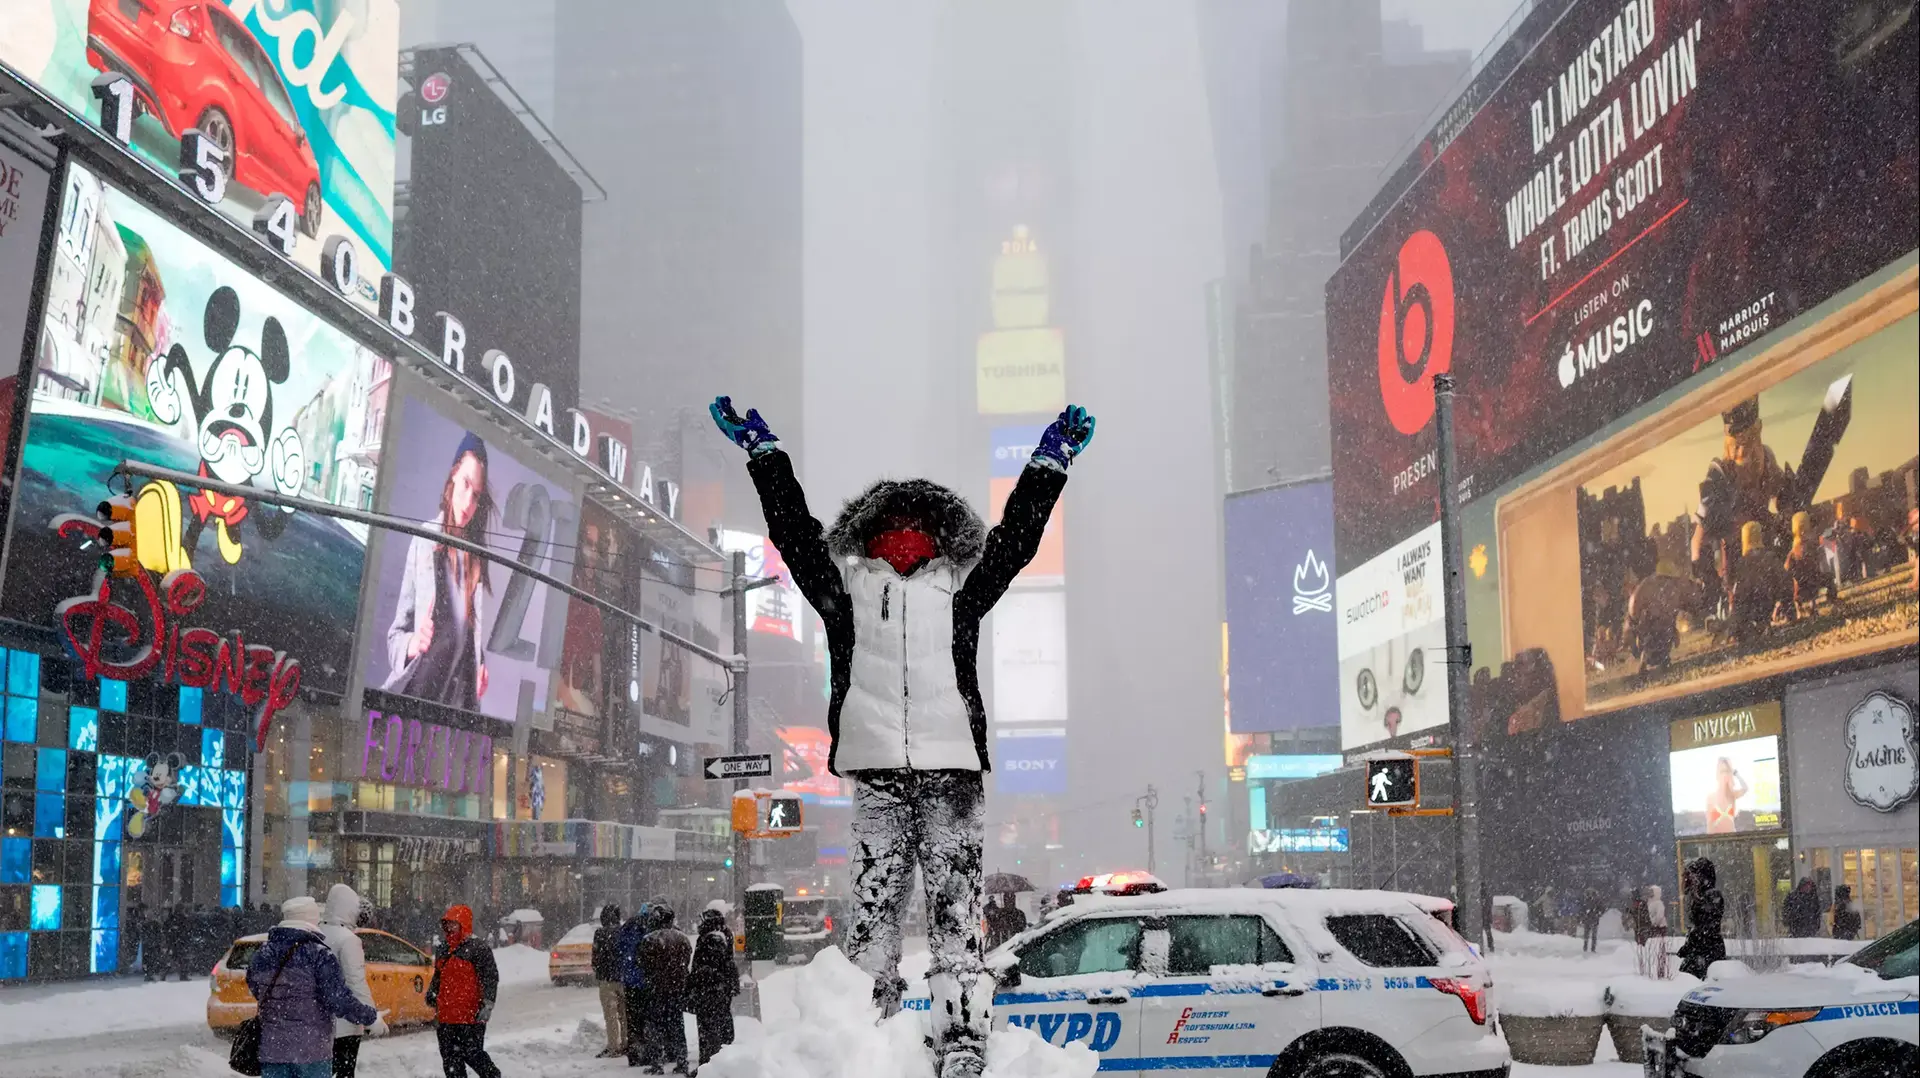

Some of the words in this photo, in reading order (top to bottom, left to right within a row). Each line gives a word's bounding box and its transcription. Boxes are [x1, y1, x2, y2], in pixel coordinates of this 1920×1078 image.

[1531, 86, 1555, 154] DJ
[1559, 0, 1655, 127] MUSTARD
[422, 108, 446, 125] LG
[1506, 152, 1566, 249] WHOLE
[1569, 97, 1626, 195] LOTTA
[1631, 18, 1701, 140] LOVIN'
[1540, 236, 1561, 280] FT.
[1563, 188, 1611, 262] TRAVIS
[1615, 143, 1662, 219] SCOTT
[1575, 291, 1608, 325] LISTEN
[1613, 274, 1630, 296] ON
[1720, 292, 1775, 334] MARRIOTT
[1578, 299, 1653, 377] MUSIC
[1721, 312, 1770, 351] MARQUIS
[981, 362, 1060, 379] TOSHIBA
[390, 275, 680, 518] BROADWAY
[1393, 448, 1438, 495] PRESEN
[1402, 541, 1431, 569] ALWAYS
[1404, 562, 1426, 586] WANT
[1346, 592, 1383, 624] swatch
[1693, 711, 1756, 741] INVICTA
[361, 709, 493, 794] FOREVER
[724, 763, 742, 772] ONE
[745, 761, 764, 771] WAY
[1004, 759, 1059, 771] SONY
[902, 1000, 923, 1010] ICE
[1843, 1002, 1899, 1018] POLICE
